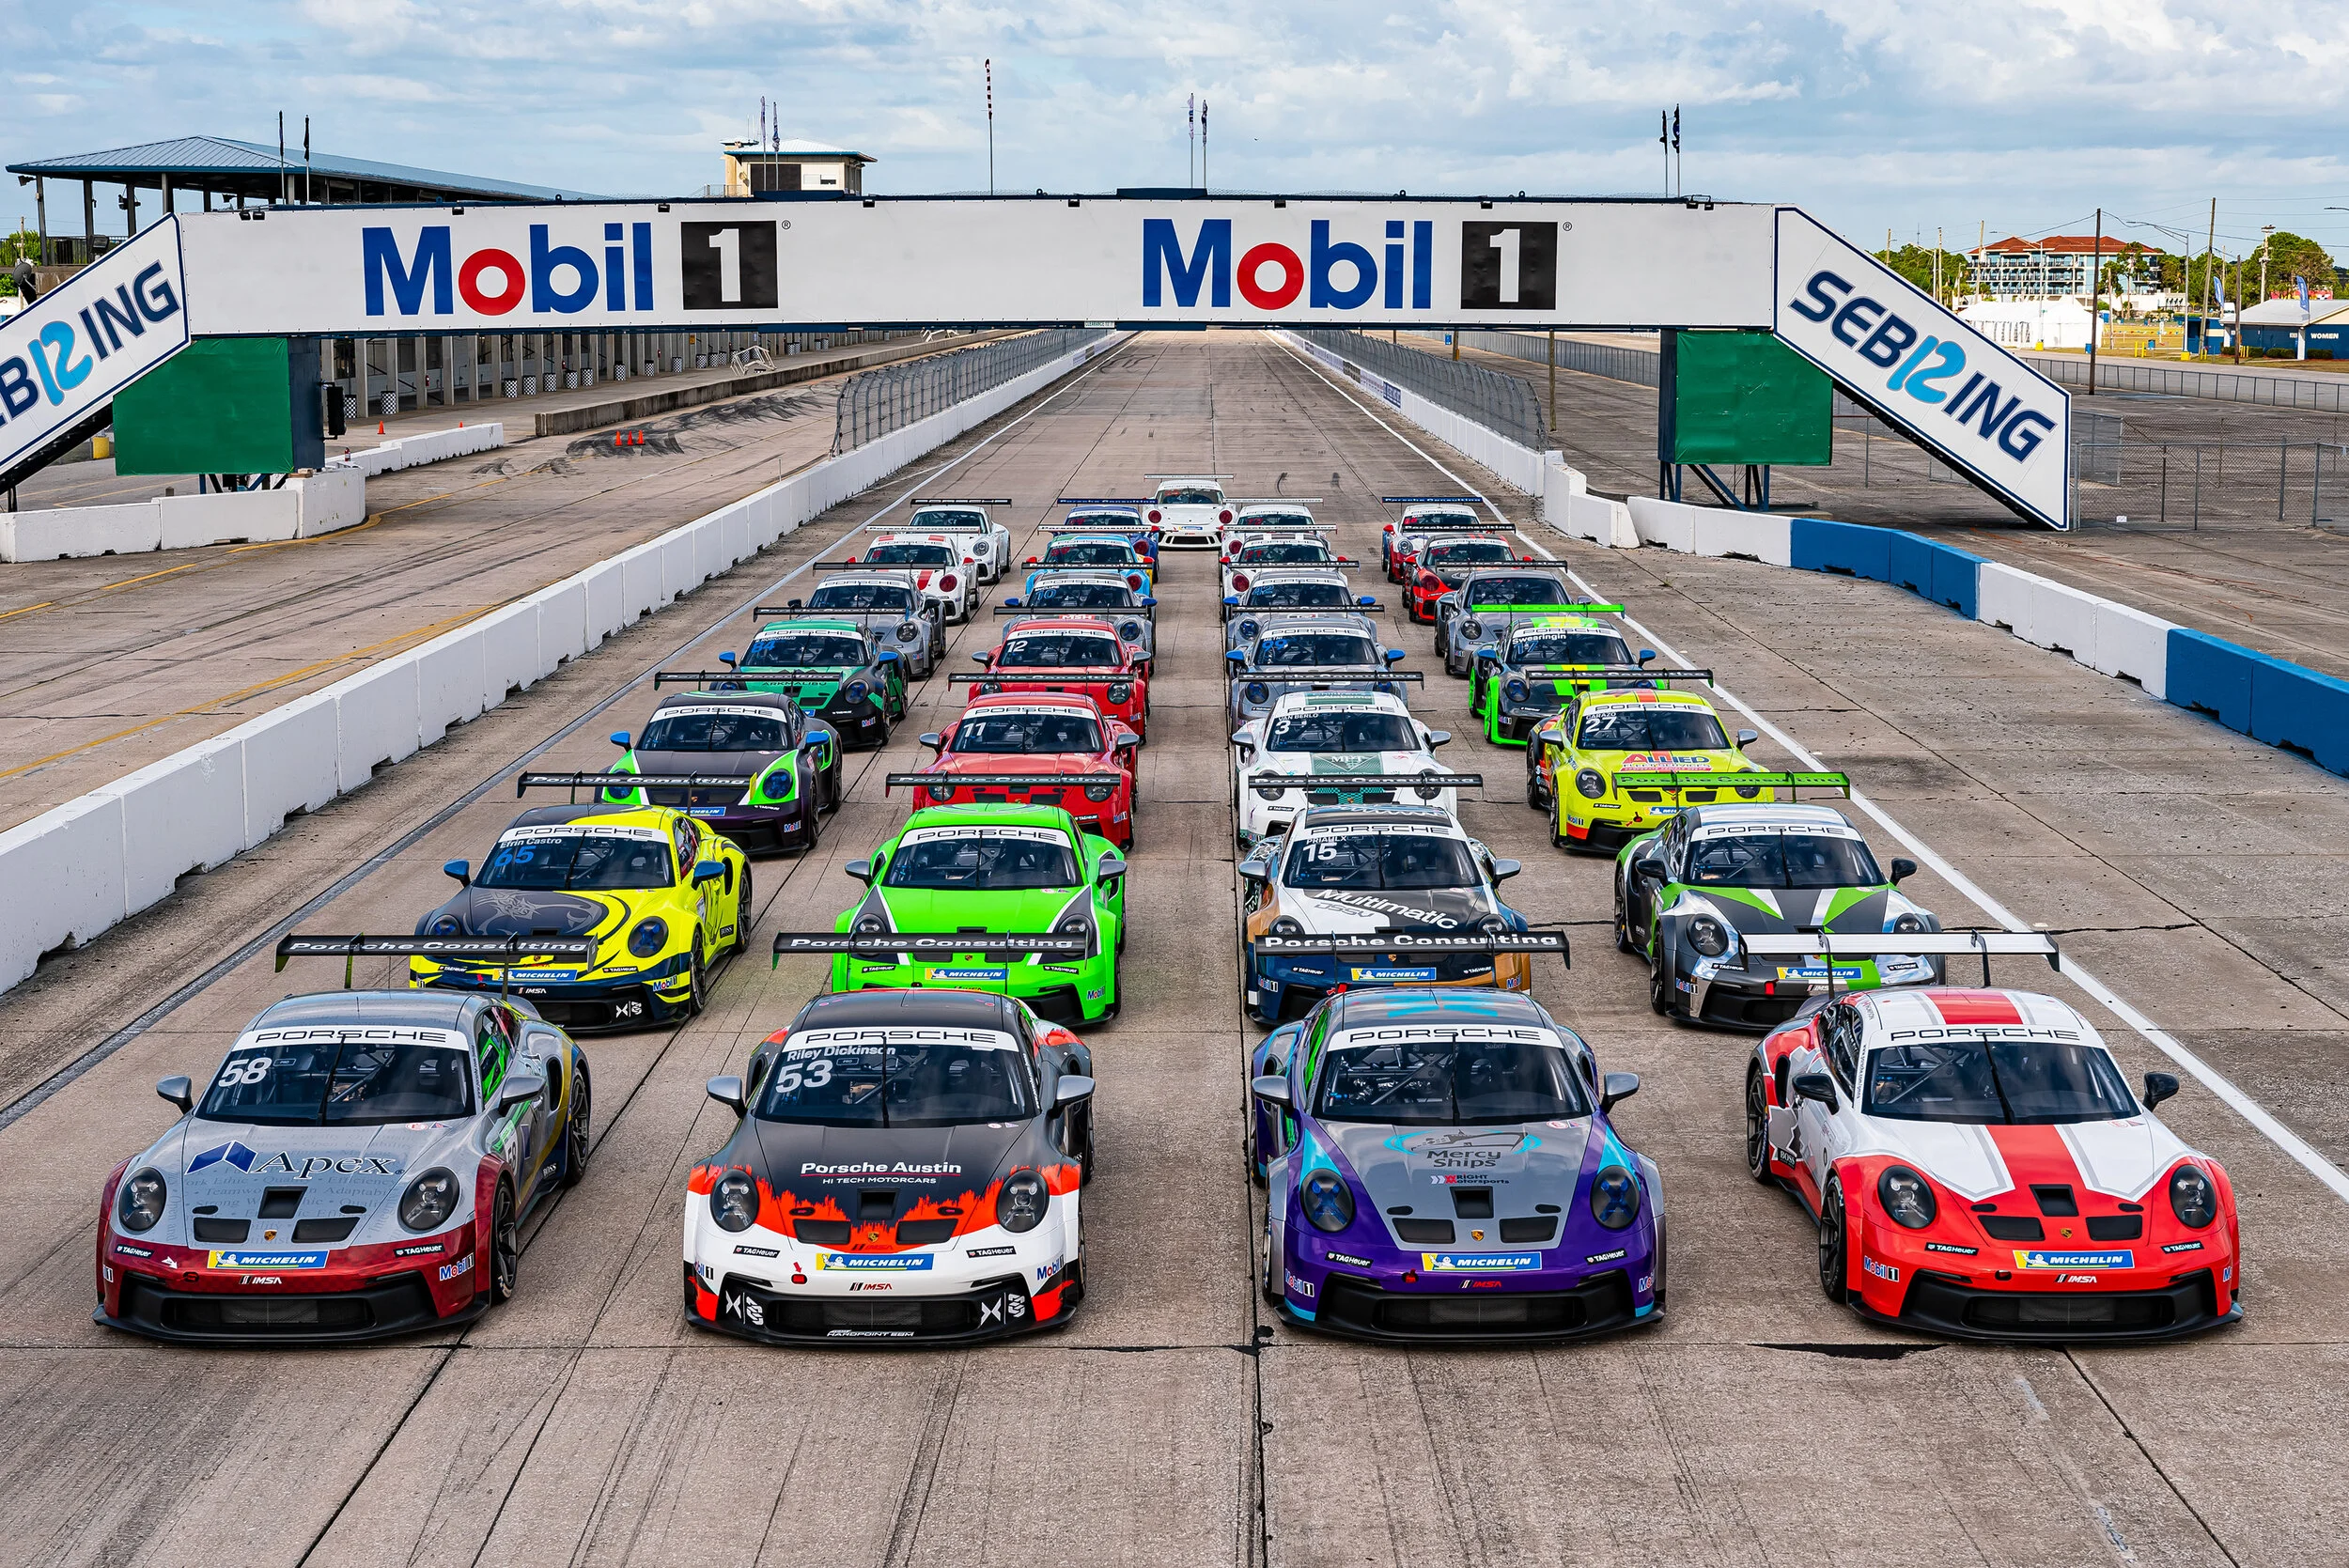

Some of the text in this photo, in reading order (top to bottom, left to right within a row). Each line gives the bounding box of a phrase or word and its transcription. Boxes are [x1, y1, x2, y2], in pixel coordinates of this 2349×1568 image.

[362, 222, 654, 317] Mobil
[1143, 219, 1433, 311] Mobil
[1523, 627, 1611, 635] PORSCHE
[1512, 633, 1567, 644] Swearingin
[751, 640, 776, 654] 84
[1006, 640, 1029, 653] 12
[1262, 638, 1288, 652] 99
[663, 706, 774, 717] PORSCHE
[974, 706, 1083, 715] PORSCHE
[1595, 703, 1703, 711] PORSCHE
[1585, 712, 1617, 721] CARAZO
[963, 722, 987, 737] 11
[1274, 720, 1291, 735] 3
[1585, 717, 1618, 734] 27
[1623, 753, 1710, 764] ALLIED
[529, 776, 748, 786] Porsche Consulting
[514, 827, 653, 838] PORSCHE
[917, 829, 1057, 842] PORSCHE
[1311, 825, 1449, 835] PORSCHE
[1707, 825, 1845, 835] PORSCHE
[526, 837, 562, 846] Castro
[1306, 835, 1346, 845] PRIAULX
[494, 846, 537, 867] 65
[1302, 843, 1337, 862] 15
[1315, 889, 1458, 929] Multimatic
[289, 941, 587, 952] Porsche Consulting
[791, 939, 1074, 949] Porsche Consulting
[1265, 935, 1558, 947] Porsche Consulting
[1376, 970, 1429, 978] MICHELIN
[652, 978, 672, 991] Mobil
[255, 1030, 446, 1044] PORSCHE
[805, 1030, 997, 1044] PORSCHE
[1349, 1027, 1542, 1043] PORSCHE
[1890, 1028, 2080, 1042] PORSCHE
[787, 1046, 895, 1063] Riley Dickinson
[218, 1057, 272, 1088] 58
[775, 1060, 833, 1094] 53
[1426, 1150, 1501, 1160] Mercy
[1779, 1150, 1796, 1165] BOSS
[251, 1151, 397, 1180] Apex
[801, 1161, 962, 1174] Porsche Austin
[1433, 1158, 1497, 1169] Ships
[870, 1176, 938, 1185] MOTORCARS
[122, 1246, 152, 1258] TAGHeuer
[404, 1244, 443, 1254] TAGHeuer
[742, 1248, 778, 1257] TAGHeuer
[976, 1248, 1014, 1256] TAGHeuer
[1936, 1244, 1977, 1254] TAGHeuer
[2170, 1242, 2201, 1251] TAGHeuer
[240, 1256, 318, 1265] MICHELIN
[848, 1258, 925, 1266] MICHELIN
[1335, 1253, 1371, 1266] TAGHeuer
[1456, 1257, 1532, 1266] MICHELIN
[1593, 1250, 1625, 1262] TAGHeuer
[2049, 1255, 2123, 1265] MICHELIN
[440, 1257, 467, 1281] Mobil
[1037, 1260, 1059, 1281] Mobil
[1864, 1255, 1887, 1280] Mobil
[252, 1276, 283, 1284] IMSA
[1284, 1268, 1303, 1294] Mobil
[2067, 1275, 2097, 1283] IMSA
